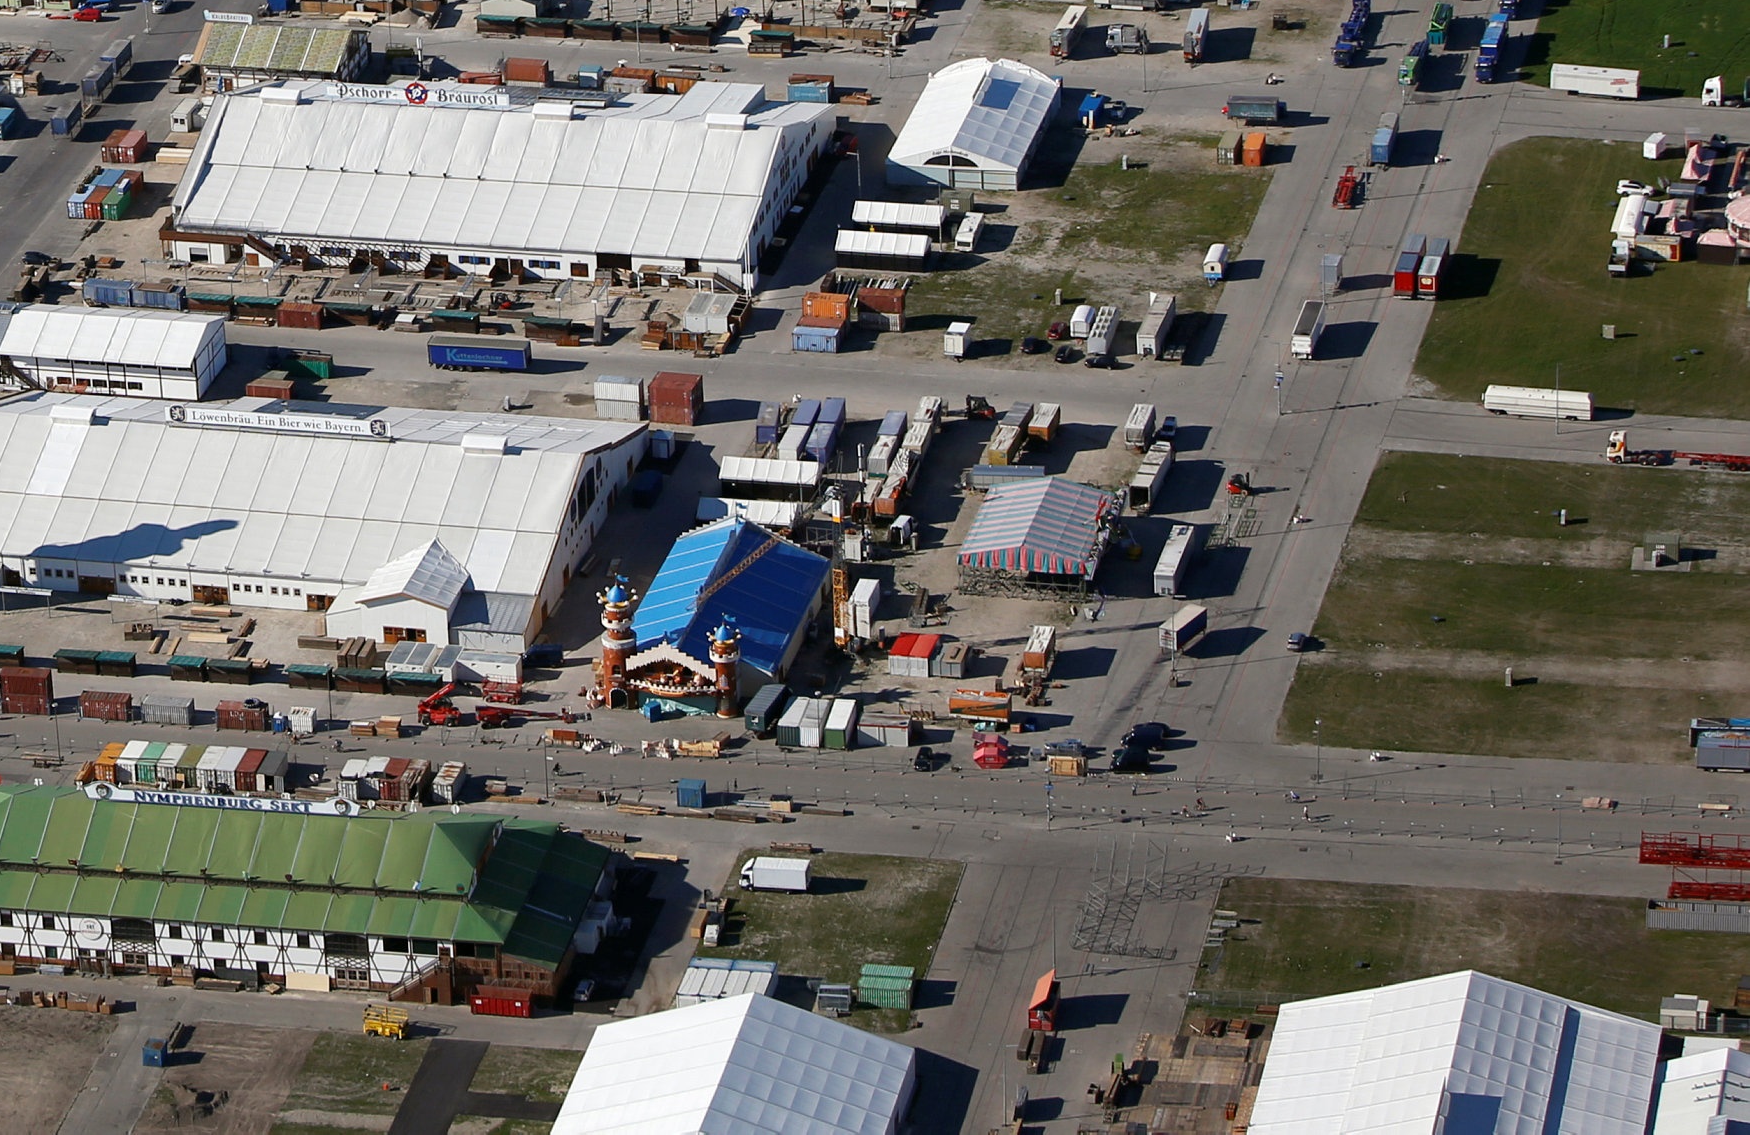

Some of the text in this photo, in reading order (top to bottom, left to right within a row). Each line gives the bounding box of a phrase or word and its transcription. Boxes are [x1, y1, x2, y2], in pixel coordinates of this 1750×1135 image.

[335, 83, 499, 106] Pschorr- Bräurosl
[192, 410, 365, 434] Löwenbräu. Ein Bier wie Bayern.
[134, 789, 313, 813] NYMPHENBURG SEKT
